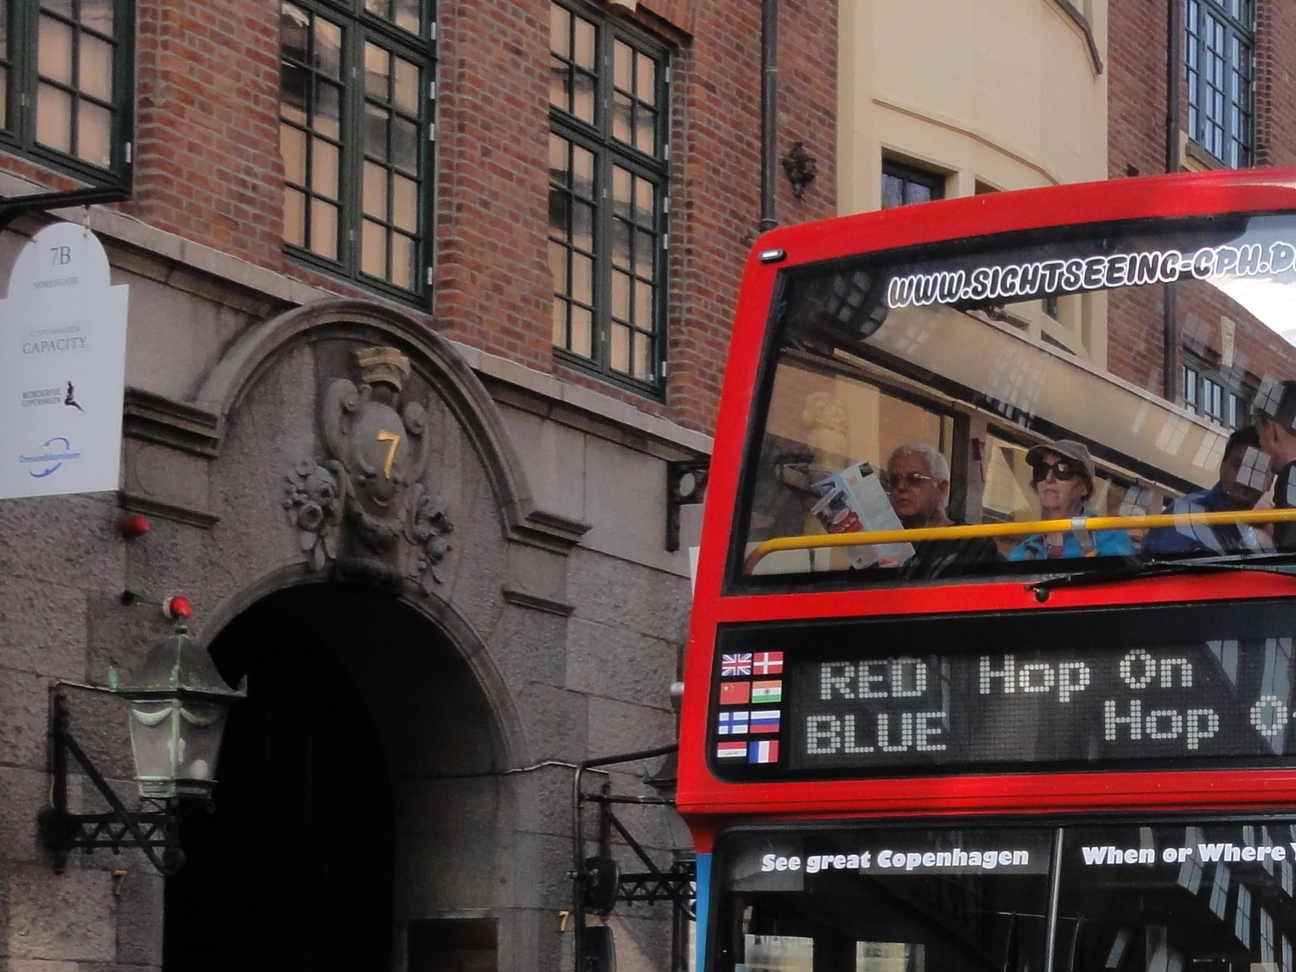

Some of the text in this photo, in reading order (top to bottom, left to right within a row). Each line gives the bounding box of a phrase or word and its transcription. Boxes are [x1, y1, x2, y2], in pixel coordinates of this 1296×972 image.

[50, 245, 72, 266] 7B
[22, 335, 88, 354] CAPACITY
[377, 428, 400, 480] 7
[820, 649, 1194, 703] RED Hop On
[806, 711, 947, 755] BLUE
[1103, 699, 1220, 750] Hop
[761, 848, 1029, 874] See great Copenhagen
[1082, 845, 1156, 865] When
[1162, 846, 1192, 863] or
[1198, 843, 1286, 862] Where
[559, 911, 569, 931] 7
